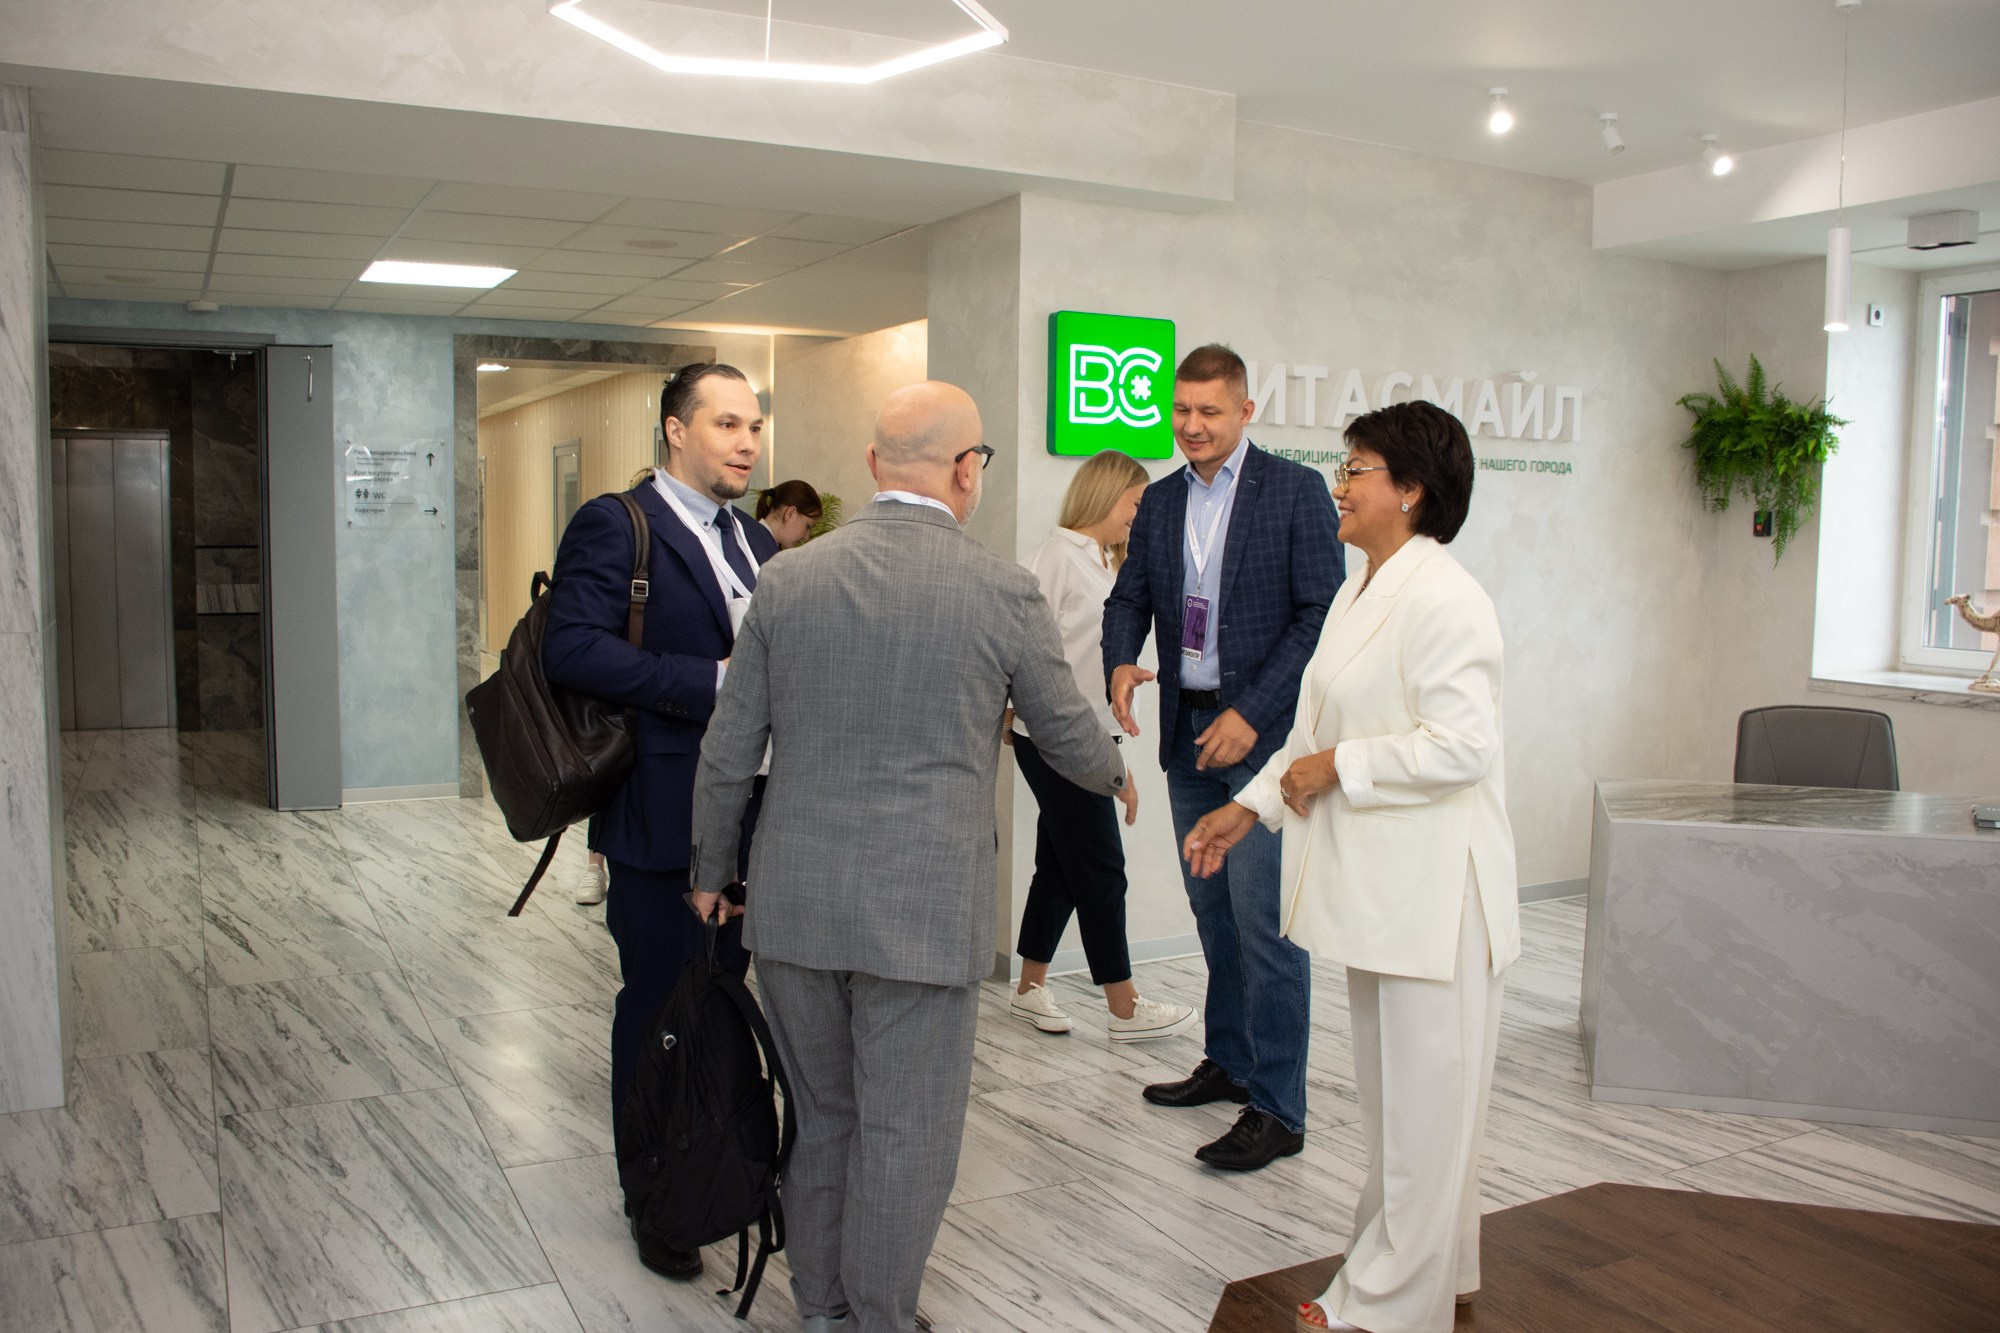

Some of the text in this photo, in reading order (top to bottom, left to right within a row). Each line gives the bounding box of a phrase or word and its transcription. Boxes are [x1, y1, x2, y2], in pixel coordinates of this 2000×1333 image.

[1246, 360, 1583, 442] ИТАСМАЙЛ
[1274, 449, 1350, 465] МЕДИЦИНС
[1480, 458, 1527, 472] НАШЕГО
[1530, 460, 1573, 475] ГОРОДА
